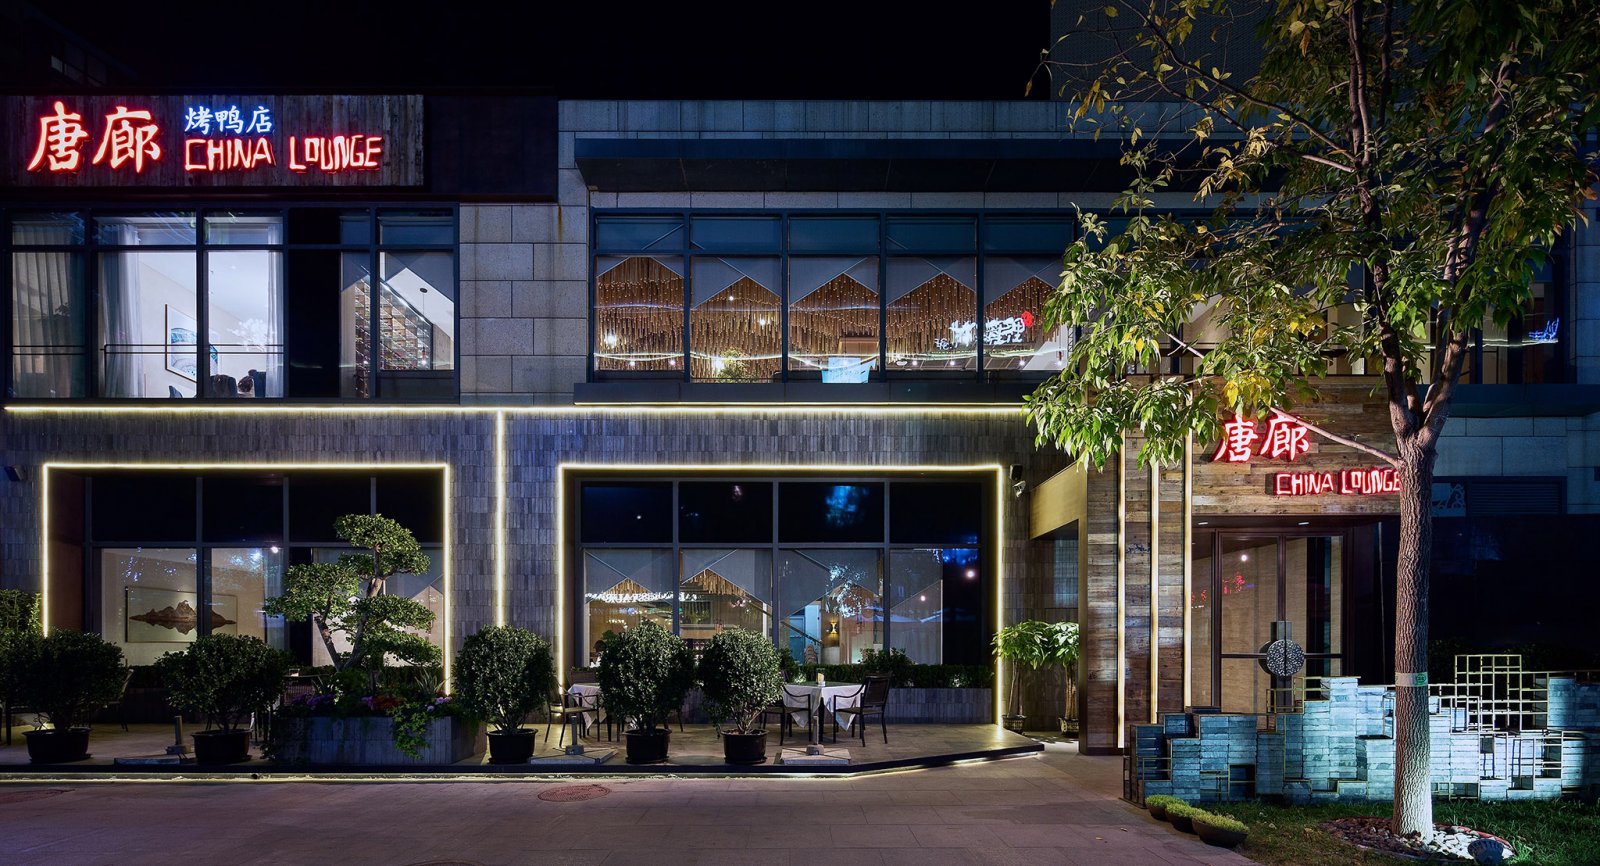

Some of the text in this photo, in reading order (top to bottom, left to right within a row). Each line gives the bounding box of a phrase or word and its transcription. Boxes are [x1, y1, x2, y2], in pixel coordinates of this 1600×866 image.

[27, 101, 161, 173] 唐廊
[184, 106, 273, 134] 烤鸭店
[185, 136, 383, 171] CHINA LOUNGE
[1214, 411, 1310, 461] 唐廊
[1275, 469, 1400, 495] CHINA LOUNGE
